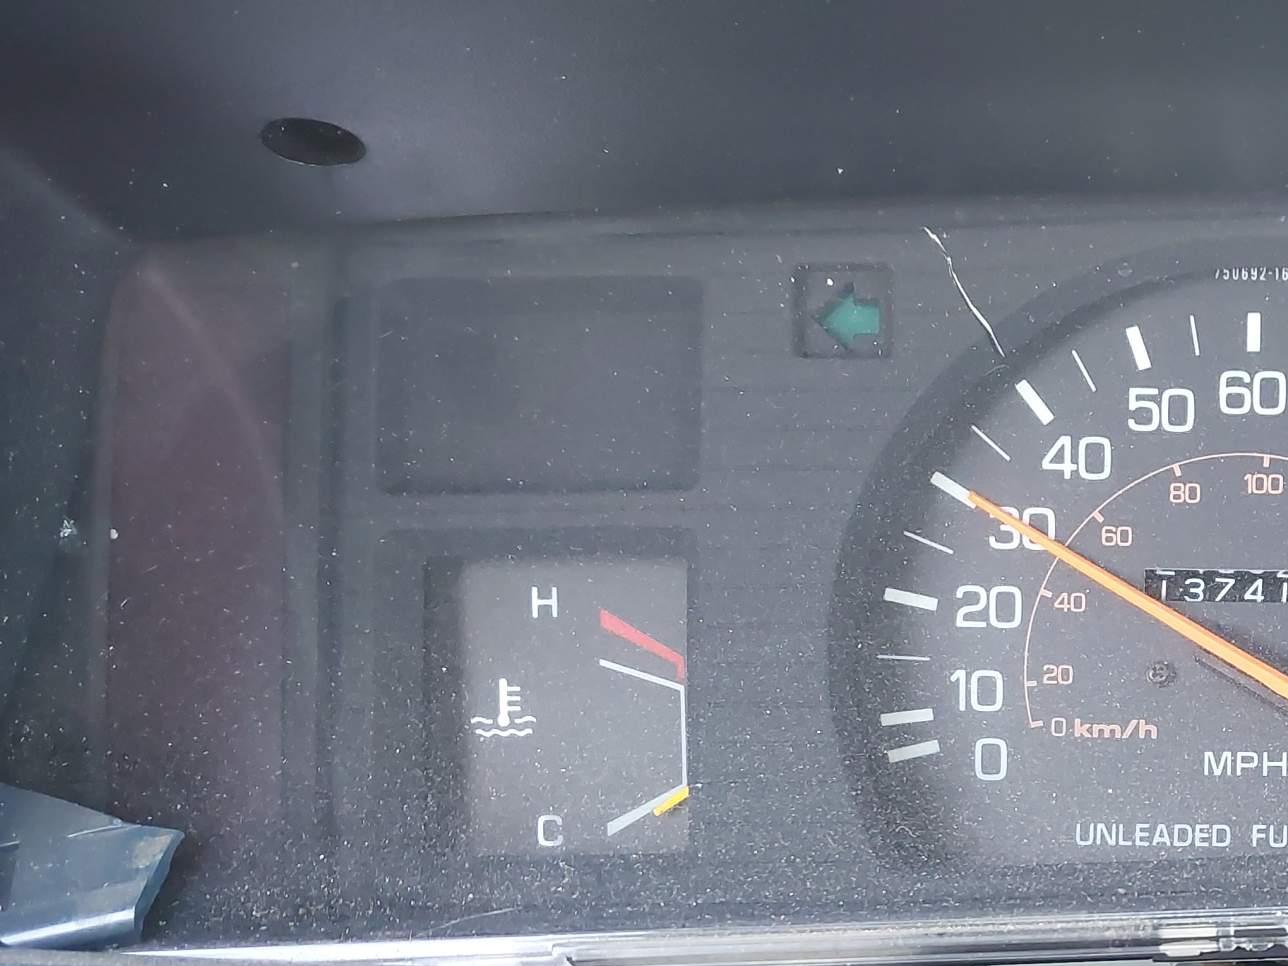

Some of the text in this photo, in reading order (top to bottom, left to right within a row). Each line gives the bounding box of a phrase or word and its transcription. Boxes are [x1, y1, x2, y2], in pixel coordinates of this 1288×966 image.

[1218, 370, 1287, 416] 60
[1127, 387, 1195, 433] 50
[1041, 435, 1112, 481] 40
[1169, 482, 1201, 504] 80
[1243, 473, 1284, 495] 100
[988, 506, 1057, 551] 30
[1101, 525, 1133, 547] 60
[530, 586, 559, 618] H
[955, 584, 1022, 629] 20
[1053, 591, 1087, 613] 40
[1042, 663, 1074, 685] 20
[950, 669, 1004, 712] 10
[1050, 717, 1158, 740] 0 km/h
[974, 737, 1008, 781] 0
[1203, 751, 1288, 777] MPH
[537, 814, 564, 847] C
[1075, 822, 1231, 849] UNLEADED
